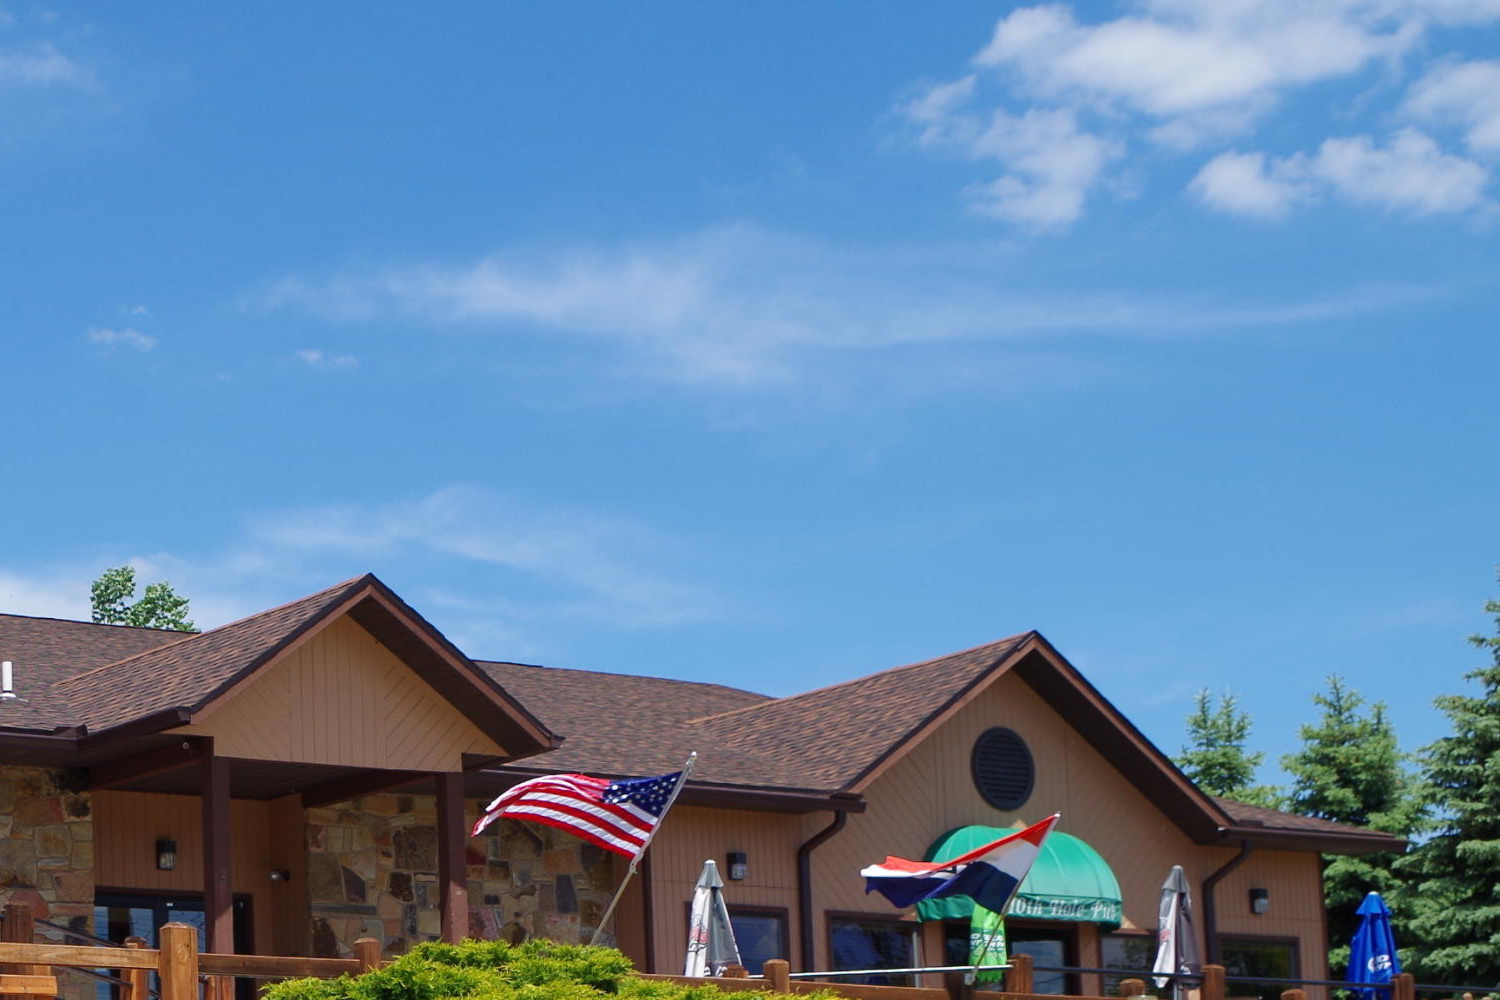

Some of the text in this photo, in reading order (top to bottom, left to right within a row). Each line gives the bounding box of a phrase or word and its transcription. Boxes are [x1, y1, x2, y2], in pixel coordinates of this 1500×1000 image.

[1007, 896, 1117, 920] 10th Hole Pub
